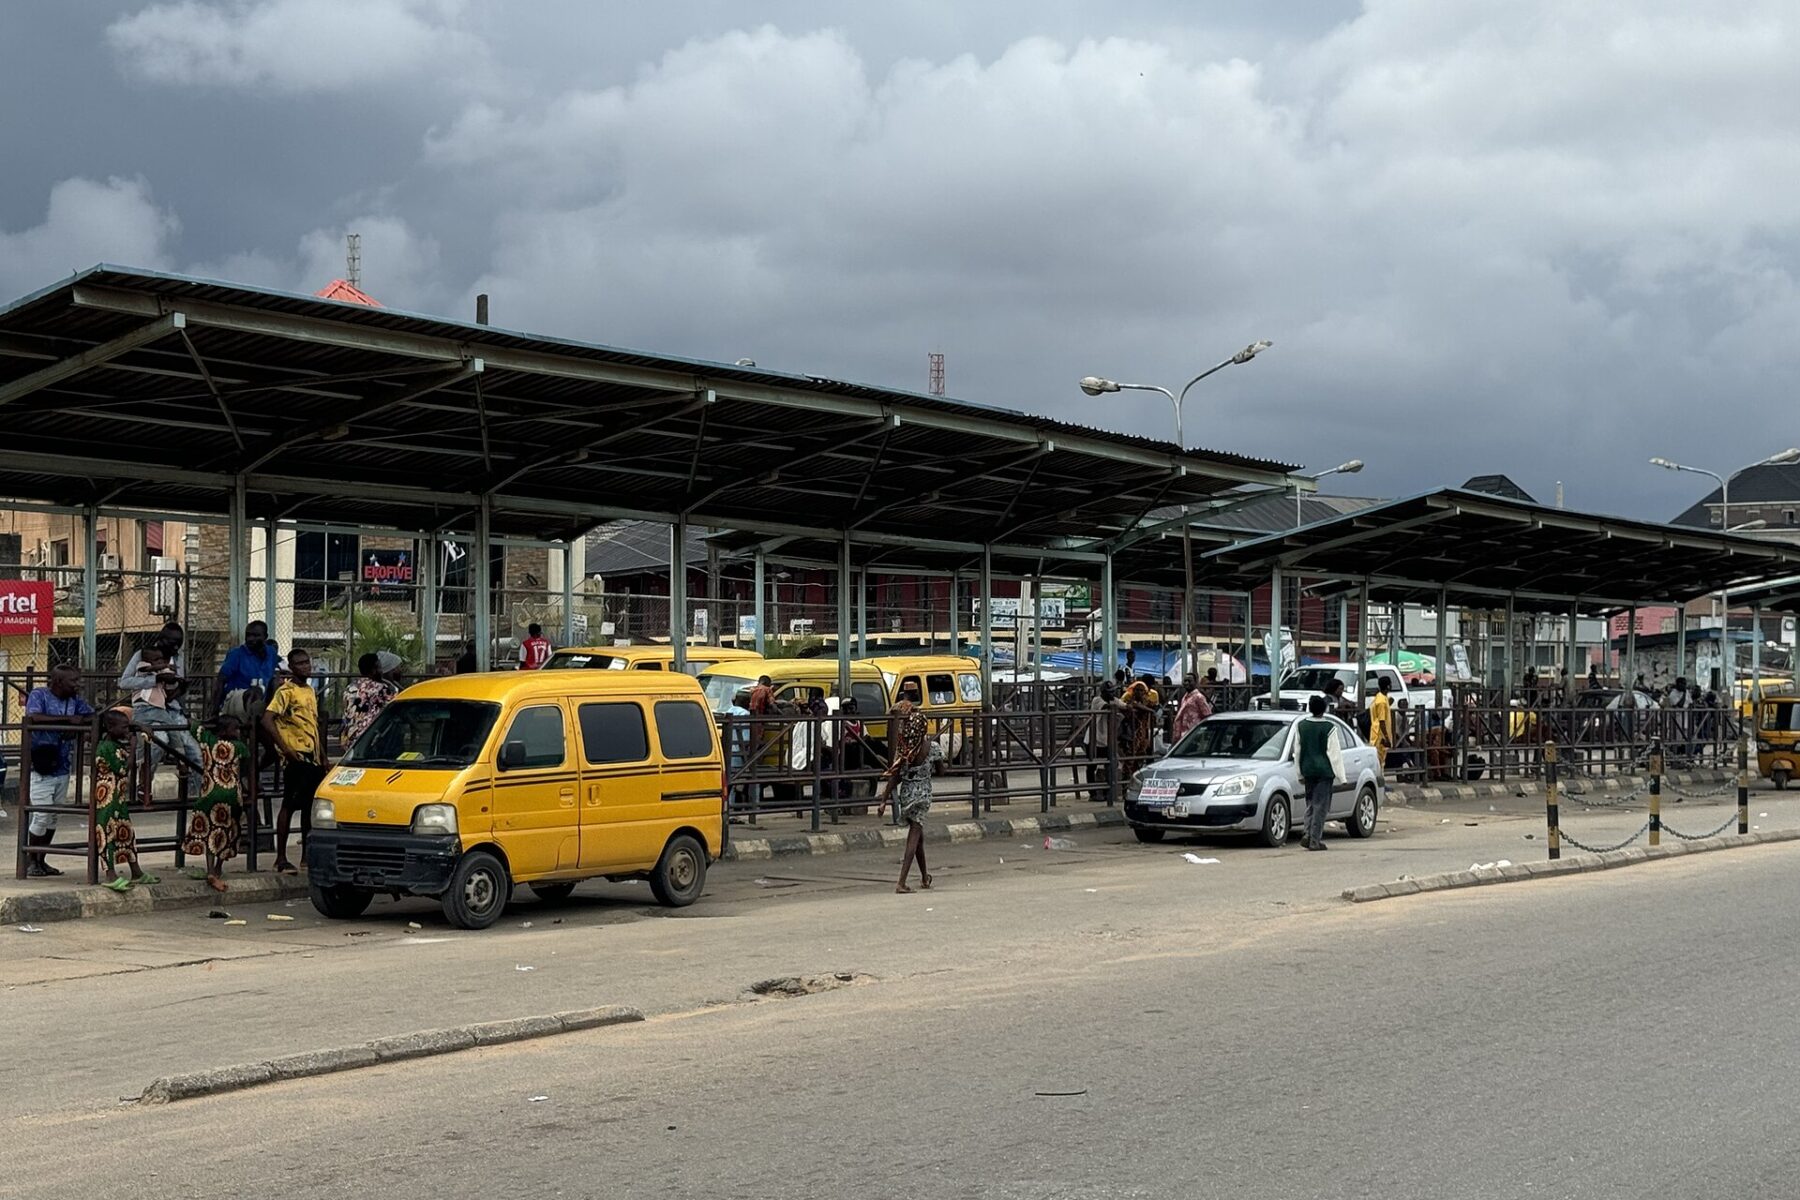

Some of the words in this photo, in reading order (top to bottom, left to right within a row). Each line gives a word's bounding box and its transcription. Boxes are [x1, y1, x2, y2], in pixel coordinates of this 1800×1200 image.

[364, 565, 412, 580] EKOFIVE
[4, 616, 38, 624] IMAGINE
[533, 645, 547, 663] 17
